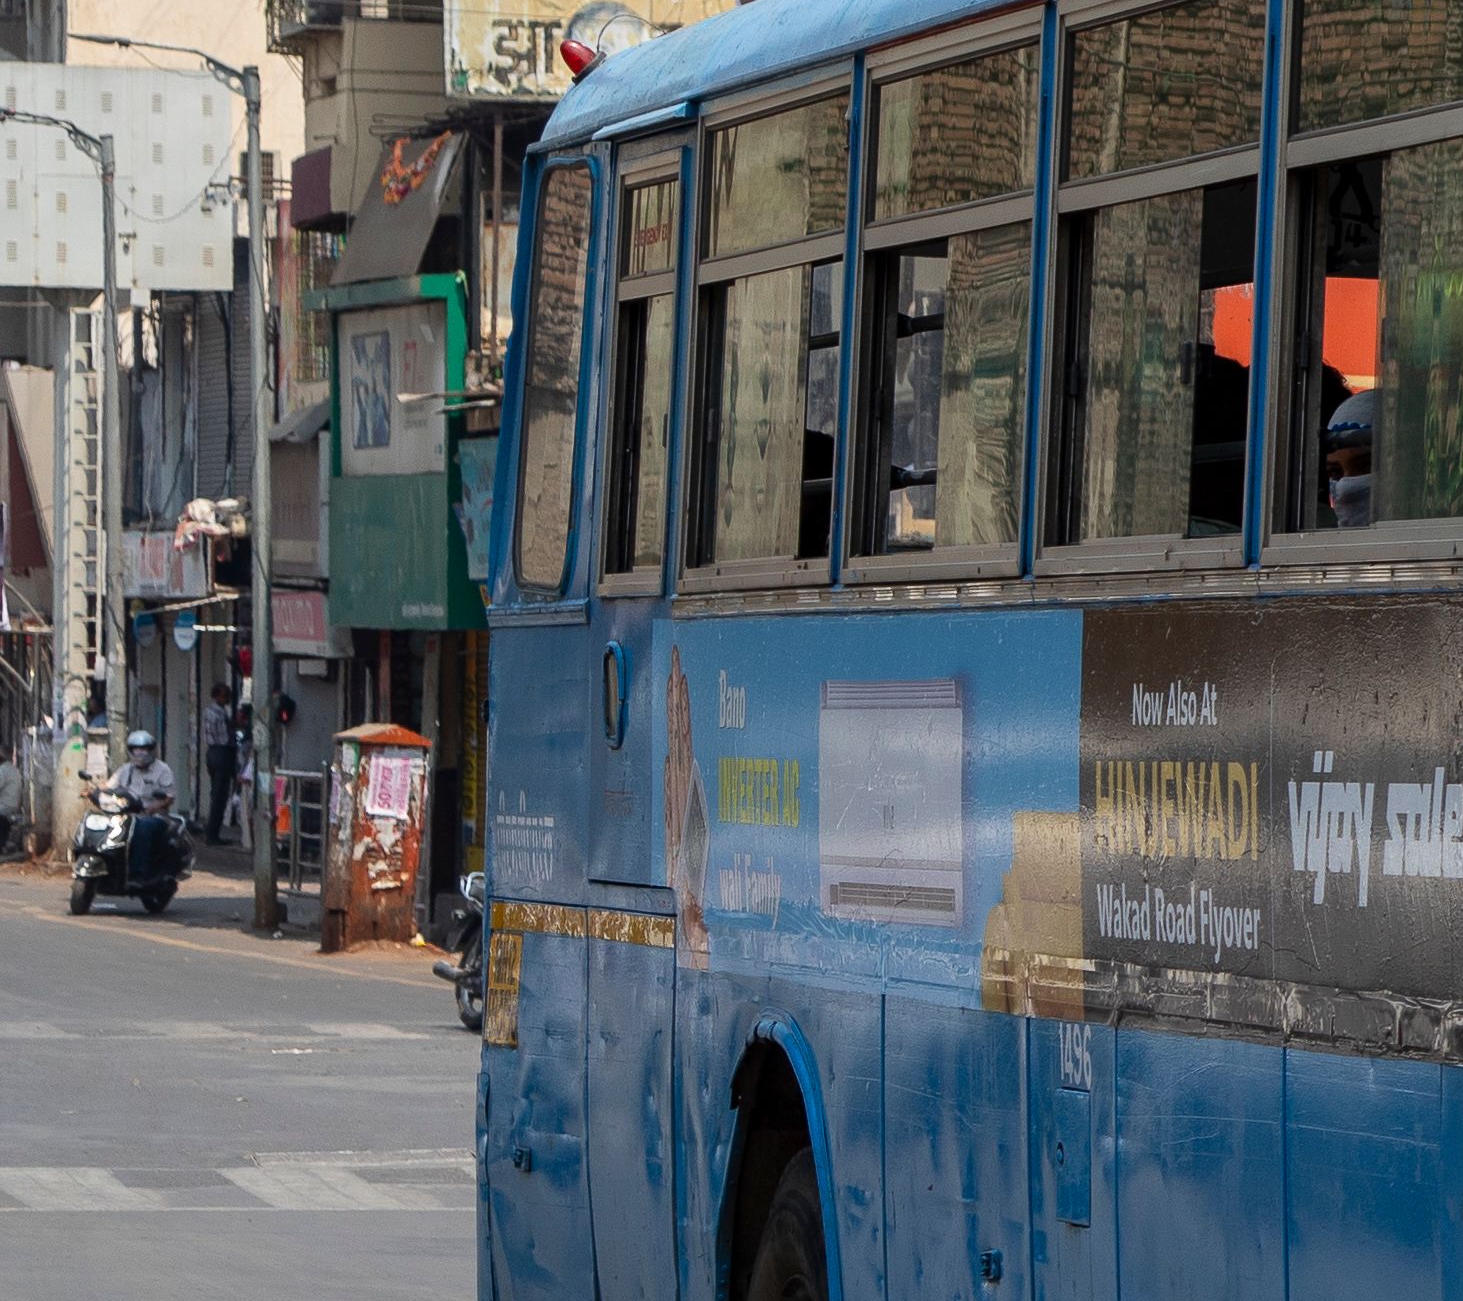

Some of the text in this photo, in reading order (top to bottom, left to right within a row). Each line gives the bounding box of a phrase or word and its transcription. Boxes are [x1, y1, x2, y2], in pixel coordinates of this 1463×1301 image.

[718, 668, 747, 731] Bano
[1131, 681, 1219, 727] Now Also At
[718, 756, 801, 829] INVERTER AC
[1094, 760, 1260, 863] HINJEWADI
[1288, 750, 1375, 907] vijay
[718, 852, 782, 931] wali Family
[1095, 881, 1261, 965] Wakad Road Flyover
[1057, 1021, 1093, 1091] 1496
